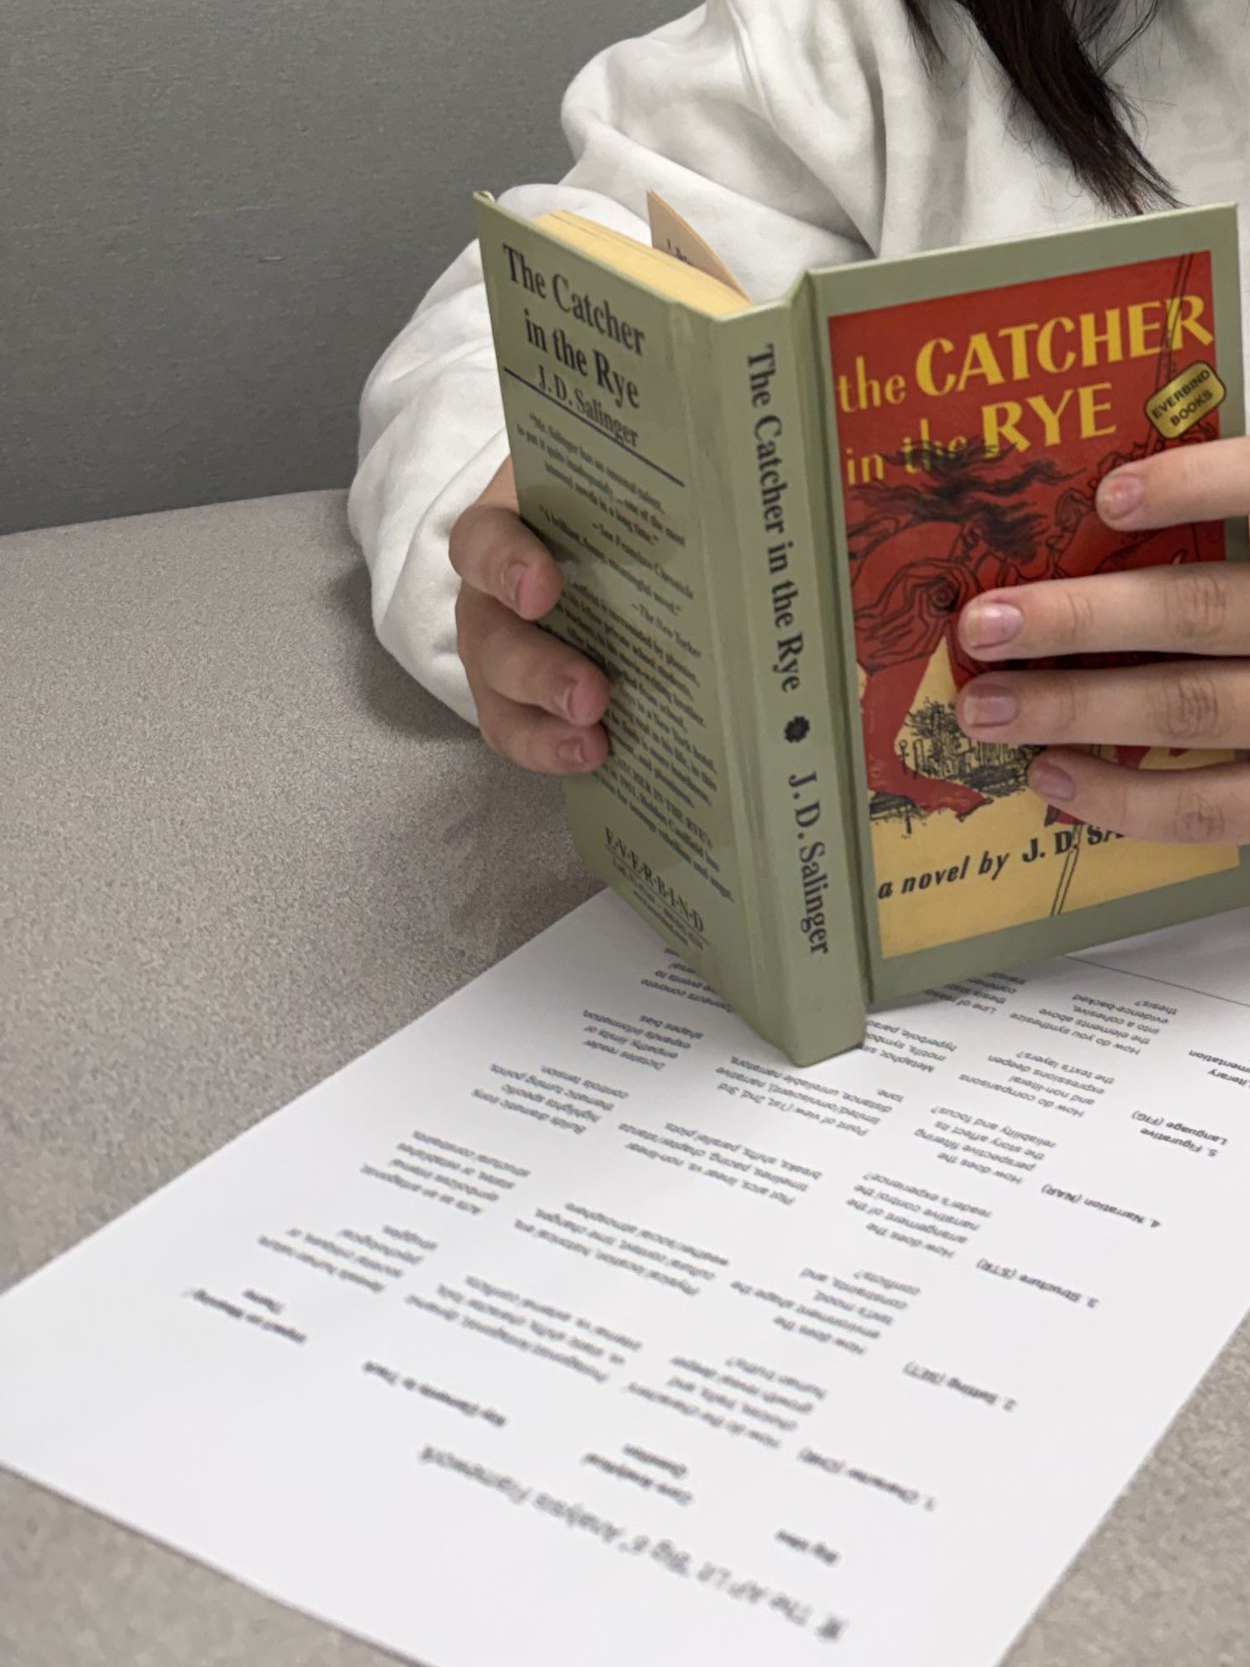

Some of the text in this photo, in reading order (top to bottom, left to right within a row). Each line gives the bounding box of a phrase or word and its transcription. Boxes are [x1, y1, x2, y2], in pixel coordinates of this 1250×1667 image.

[502, 243, 646, 356] The Catcher
[524, 308, 640, 409] in the Rye
[837, 294, 1214, 413] the CATCHER
[538, 365, 638, 448] J. D. Salinger
[1152, 370, 1210, 419] EVERBIND
[1170, 389, 1213, 426] BOOKS
[845, 382, 1117, 486] in the RYE
[747, 343, 829, 955] The Catcher in the Rye J. D. Salinger
[878, 882, 893, 899] a
[901, 855, 970, 895] novel
[978, 850, 1011, 881] by
[1022, 838, 1046, 863] J.
[1038, 1008, 1150, 1045] the elements above
[1072, 994, 1169, 1024] evidence-backed
[1072, 1005, 1125, 1026] cohesive,
[1134, 1000, 1178, 1016] thesis?
[1009, 1013, 1141, 1055] How do you synthesize
[1137, 1024, 1160, 1034] into
[1007, 1075, 1095, 1106] and non-literal
[1131, 1111, 1227, 1146] Language (FIG)
[1140, 1128, 1218, 1157] 5. Figurative
[1041, 1184, 1082, 1204] (NAR)
[1083, 1198, 1145, 1224] Narration
